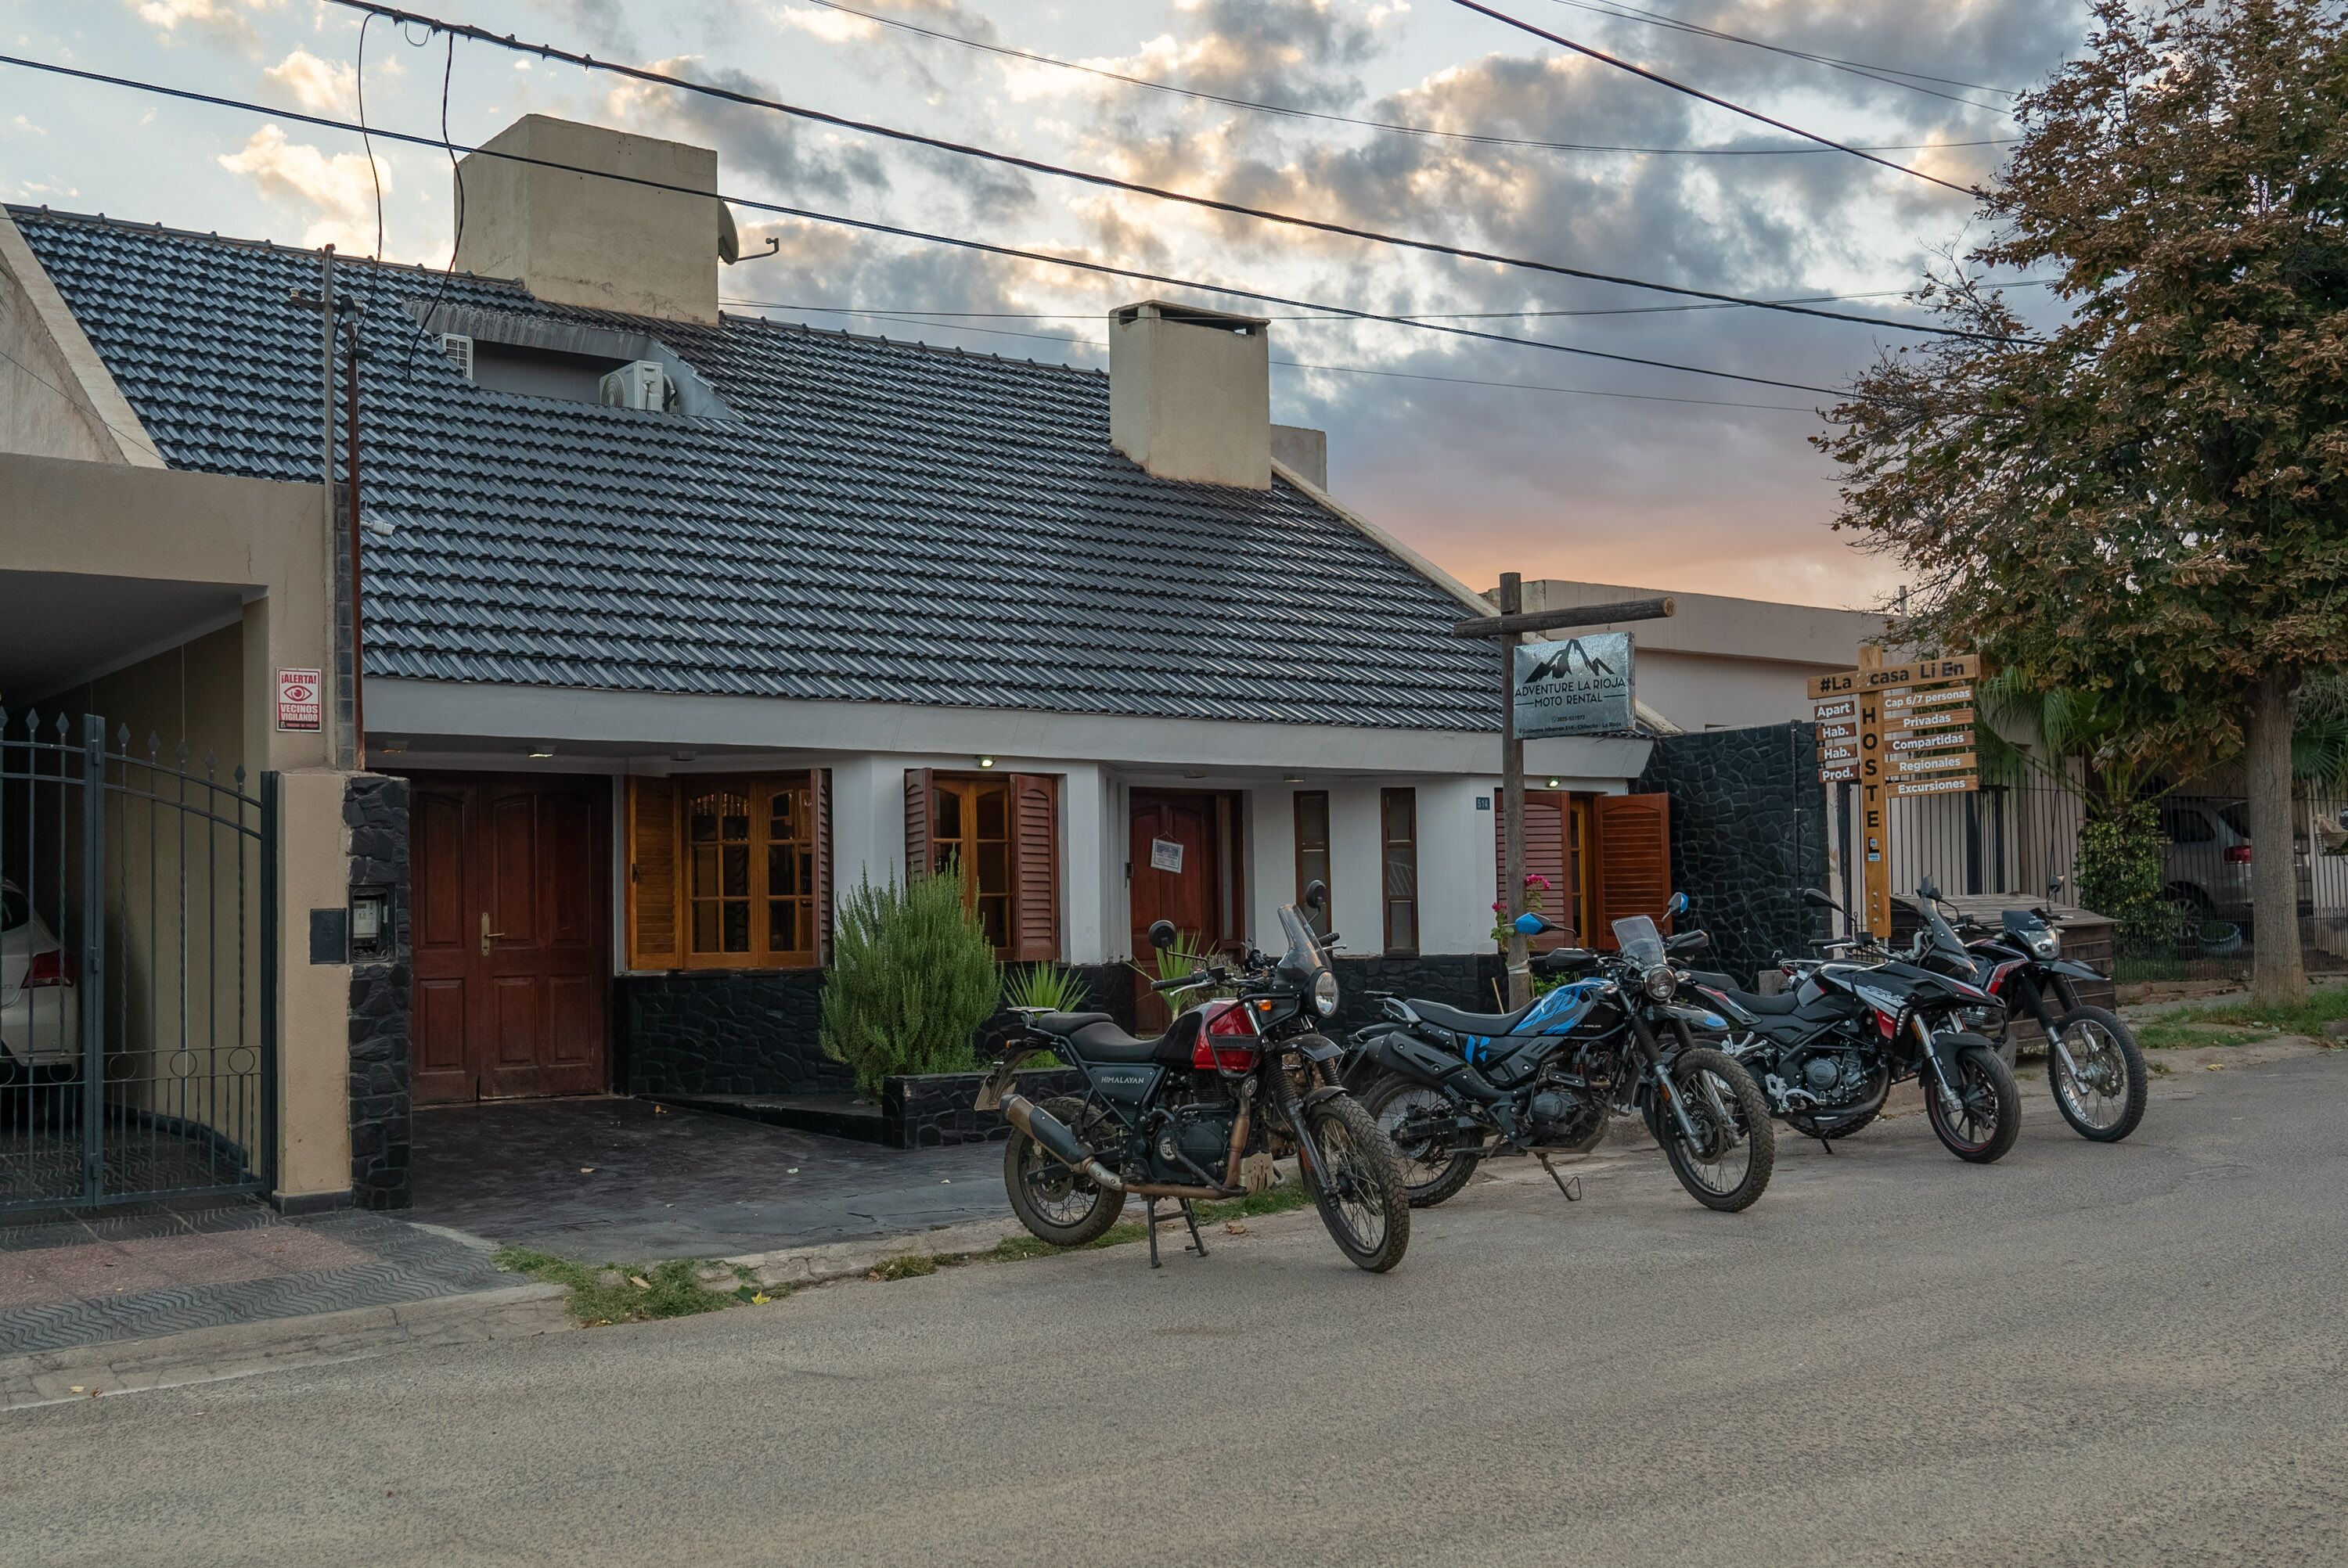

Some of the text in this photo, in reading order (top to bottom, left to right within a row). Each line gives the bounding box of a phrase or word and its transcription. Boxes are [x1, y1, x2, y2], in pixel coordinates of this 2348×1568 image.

[281, 674, 317, 684] ¡ALERTA!
[1820, 677, 1852, 692] #La
[1921, 663, 1936, 679] Li
[1942, 661, 1964, 678] En
[1514, 677, 1626, 697] ADVENTURE LA RIOJA
[1535, 692, 1603, 708] MOTO RENTAL
[1885, 689, 1971, 709] Cap 6/7 personas
[280, 703, 319, 714] VECINOS
[1817, 703, 1850, 718] Apart
[281, 713, 319, 721] VIGILANDO
[1903, 714, 1951, 728] Privadas
[1822, 723, 1849, 739] Hab.
[1892, 734, 1964, 750] Compartidas
[1824, 744, 1851, 760] Hab.
[1899, 756, 1961, 772] Regionales
[1822, 766, 1854, 781] Prod.
[1898, 779, 1966, 794] Excursiones
[1101, 1076, 1144, 1084] HIMALAYAN
